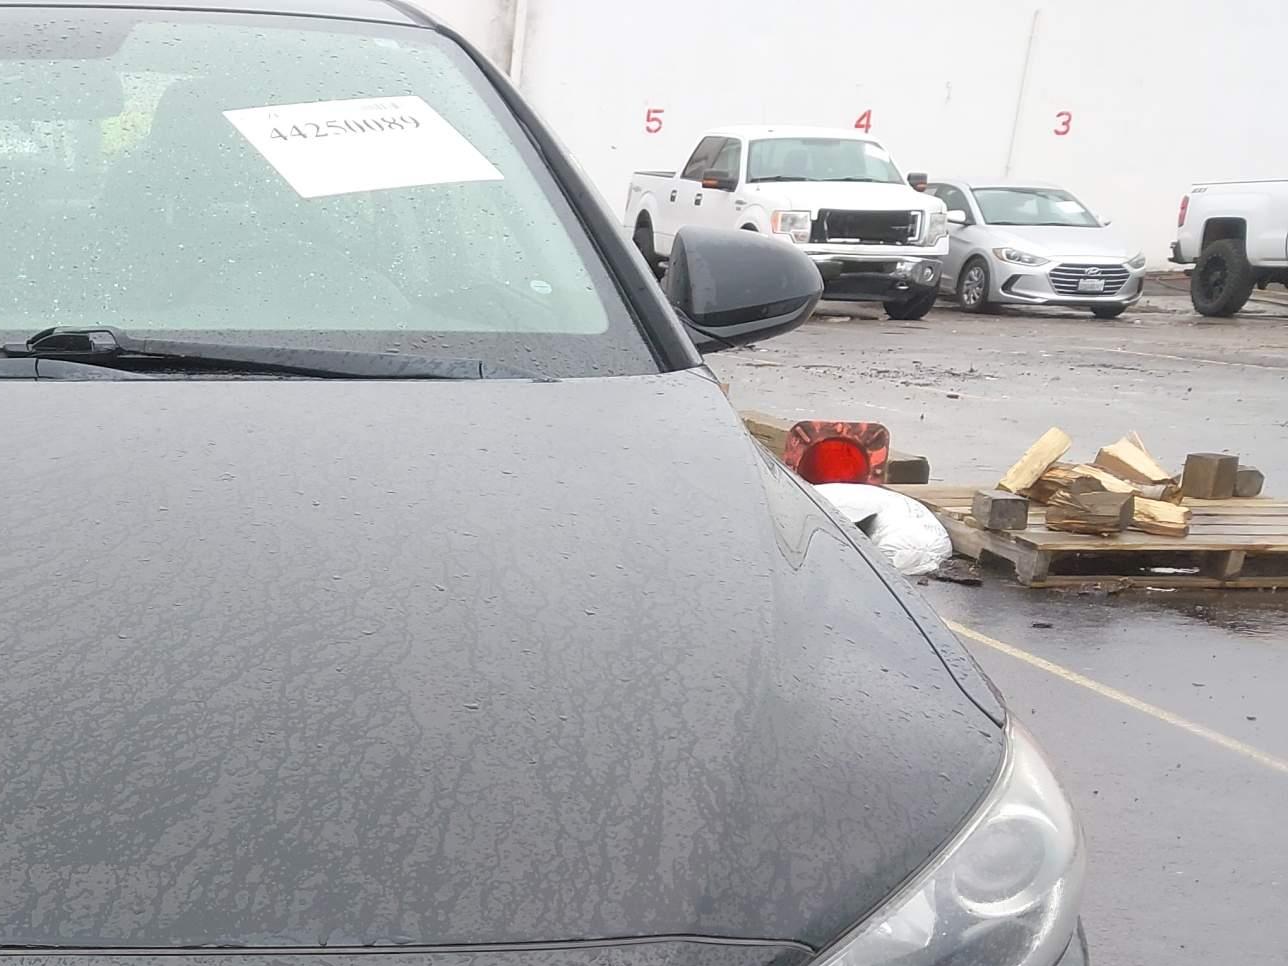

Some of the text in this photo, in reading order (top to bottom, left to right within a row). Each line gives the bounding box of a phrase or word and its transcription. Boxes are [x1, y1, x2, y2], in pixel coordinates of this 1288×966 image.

[645, 109, 665, 134] 5
[854, 109, 873, 134] 4
[1053, 110, 1073, 136] 3
